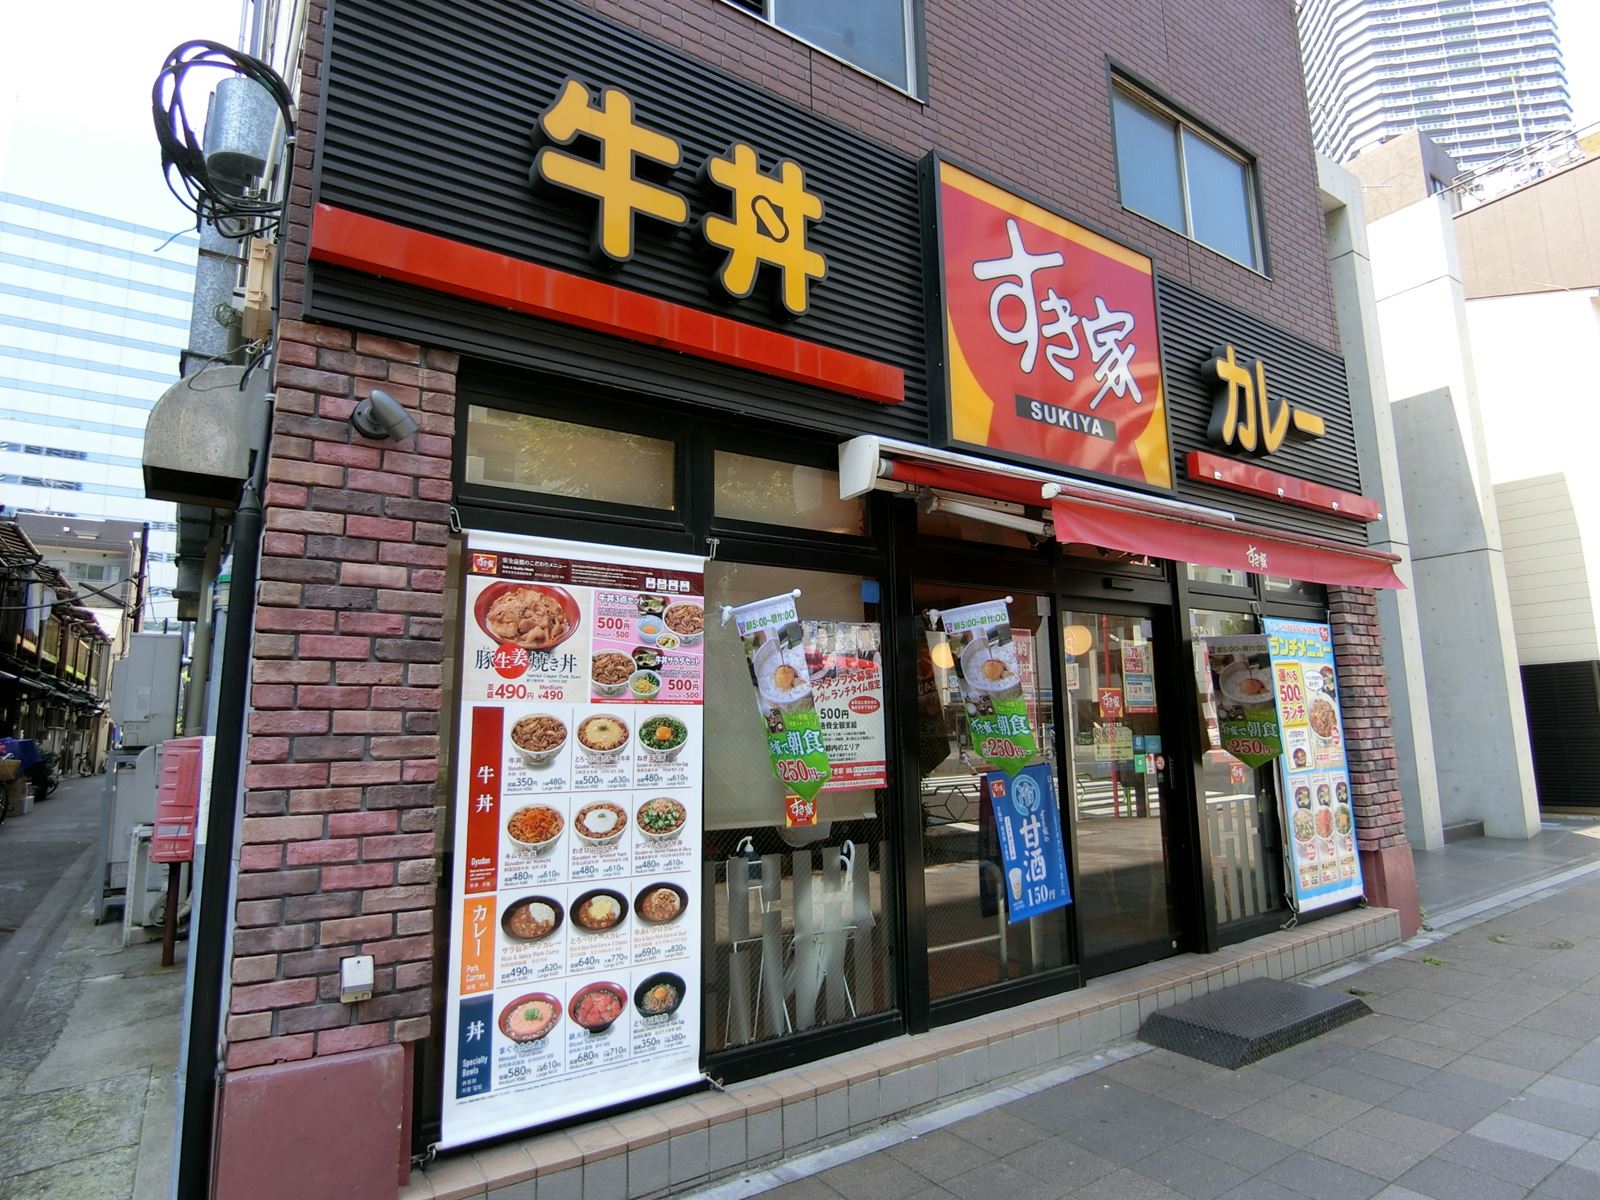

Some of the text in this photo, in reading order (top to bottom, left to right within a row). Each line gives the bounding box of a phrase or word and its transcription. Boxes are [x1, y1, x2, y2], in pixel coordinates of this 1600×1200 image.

[541, 78, 828, 315] 牛丼
[972, 217, 1143, 410] すき家
[1215, 346, 1326, 454] カレー
[1029, 401, 1104, 438] SUKIYA
[1245, 544, 1268, 570] すき家
[1268, 635, 1332, 659] ランチメニュー
[494, 683, 535, 700] 490円
[820, 707, 850, 720] 500円
[1282, 704, 1306, 721] ランチ
[476, 765, 495, 813] 牛丼
[1019, 814, 1047, 882] 甘酒
[1027, 884, 1057, 907] 150円
[472, 904, 488, 958] カレー
[466, 1020, 485, 1042] 丼
